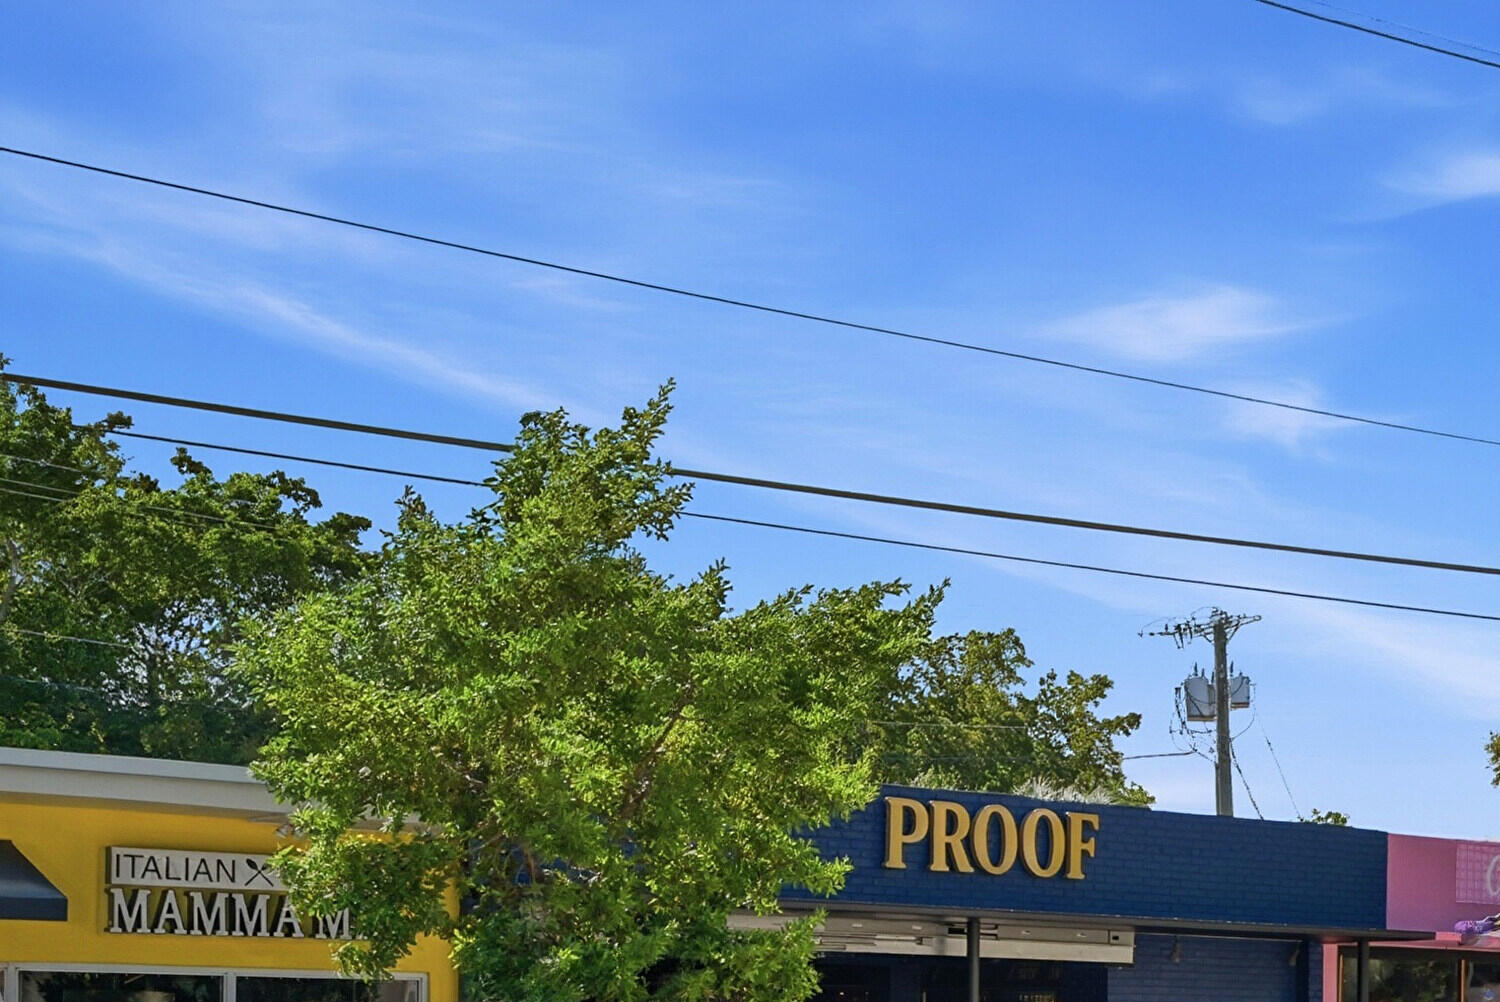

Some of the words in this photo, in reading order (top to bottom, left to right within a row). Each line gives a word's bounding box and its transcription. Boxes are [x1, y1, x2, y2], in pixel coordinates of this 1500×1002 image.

[882, 796, 1099, 880] PROOF
[115, 853, 236, 883] ITALIAN
[108, 887, 304, 939] MAMMA
